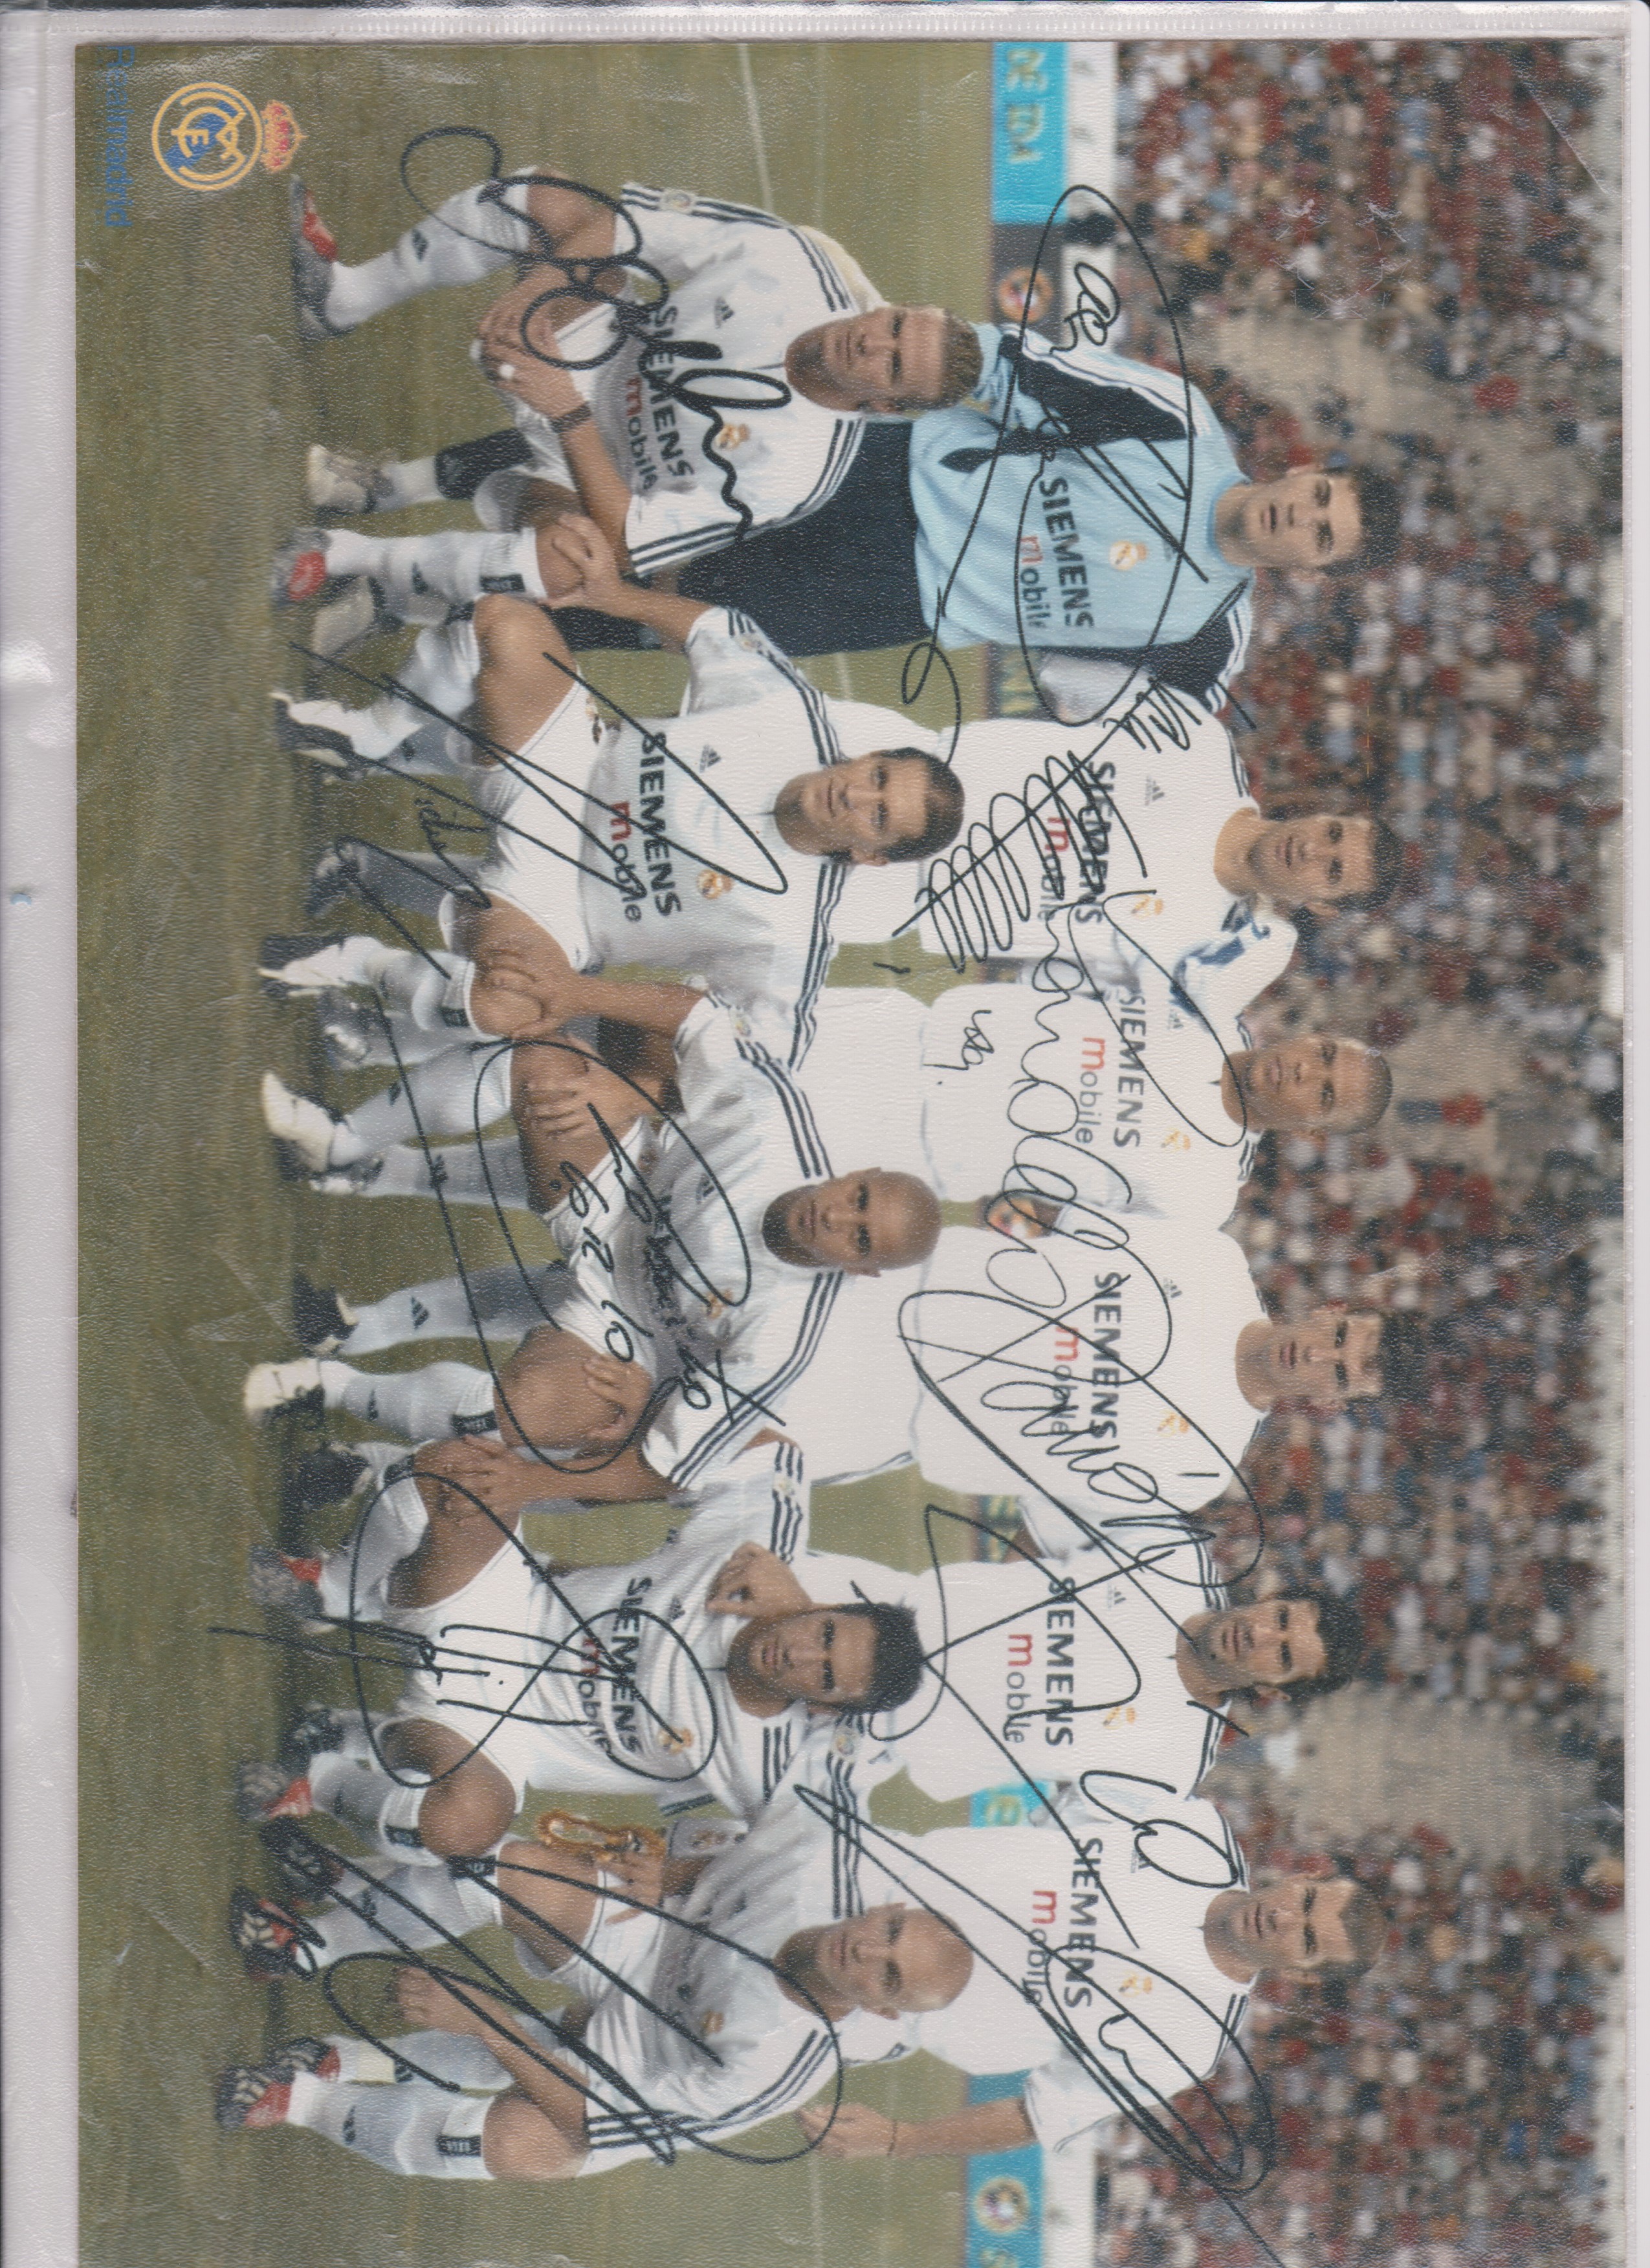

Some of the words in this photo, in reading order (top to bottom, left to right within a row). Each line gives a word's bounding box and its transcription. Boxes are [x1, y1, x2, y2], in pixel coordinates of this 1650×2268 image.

[626, 375, 659, 490] mobile
[649, 306, 694, 477] SIEMENS
[1039, 477, 1094, 627] SIEMENS
[640, 732, 682, 917] SIEMENS
[1075, 761, 1116, 924] SIEMENS
[1075, 1038, 1105, 1144] mobile
[1114, 996, 1146, 1148] SIEMENS
[1050, 1326, 1079, 1434] moble
[1089, 1272, 1121, 1439] SIEMENS
[611, 1577, 652, 1754] SIEMENS
[1045, 1577, 1076, 1747] SIEMENS
[1064, 1838, 1103, 2009] SIEMENS
